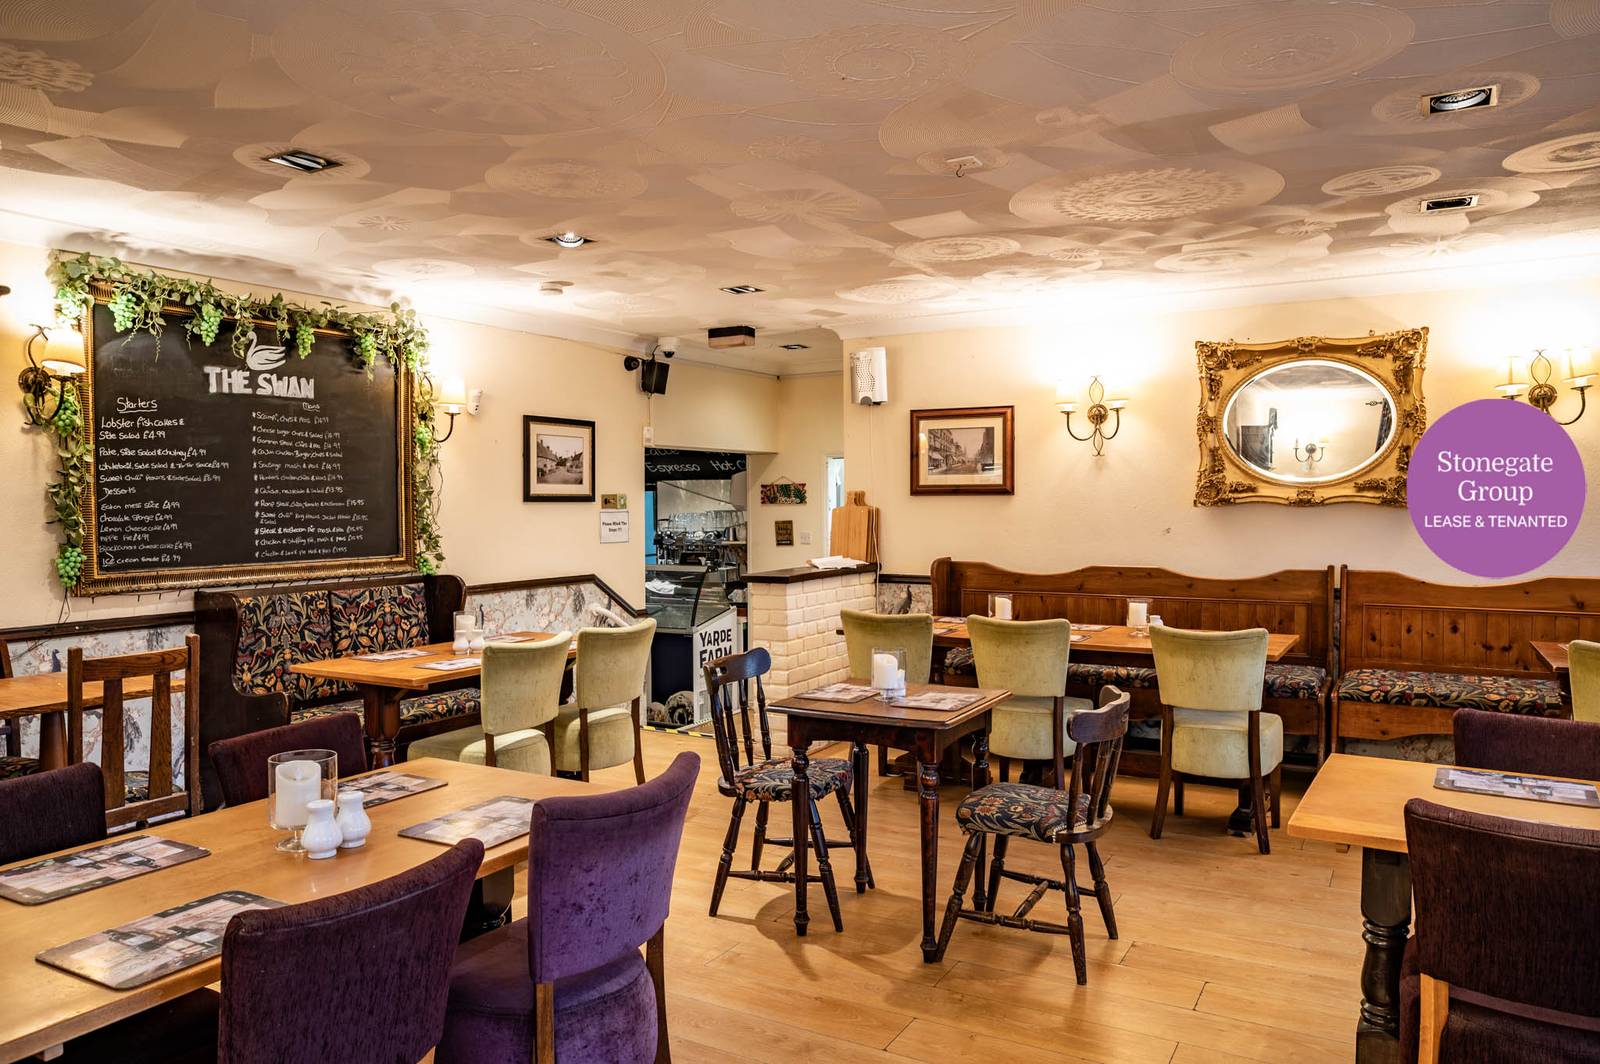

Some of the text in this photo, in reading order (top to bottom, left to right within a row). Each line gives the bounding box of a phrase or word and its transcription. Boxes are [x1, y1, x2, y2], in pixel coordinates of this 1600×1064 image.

[204, 366, 314, 400] THE SWAN
[117, 397, 158, 412] Starters
[102, 416, 134, 429] Lobster
[99, 431, 116, 440] Side
[143, 430, 165, 440] £4.99
[645, 462, 700, 474] Espresso
[710, 460, 736, 472] Hot
[699, 628, 732, 647] YARDE
